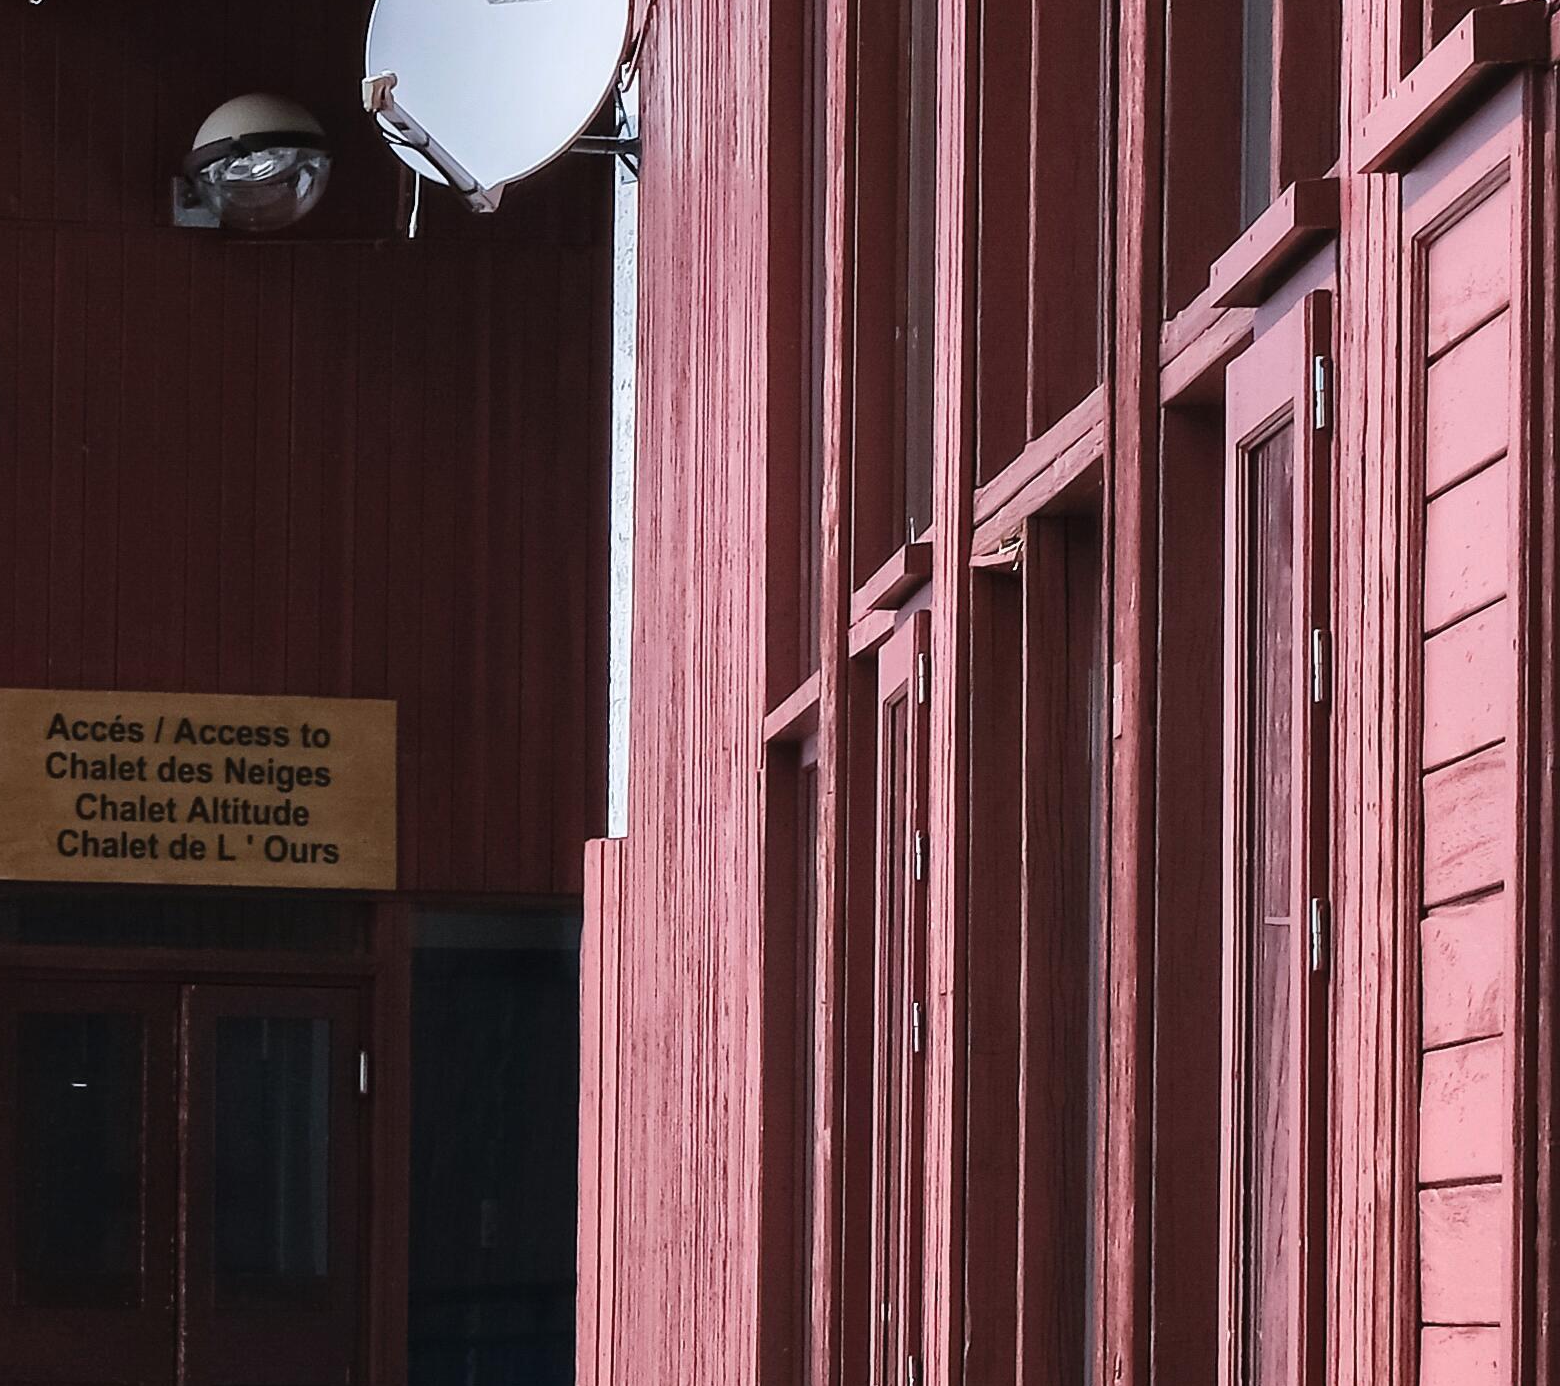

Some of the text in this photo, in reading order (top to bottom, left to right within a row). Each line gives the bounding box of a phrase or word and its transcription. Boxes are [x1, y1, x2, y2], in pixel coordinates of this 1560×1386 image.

[173, 717, 291, 748] Access
[299, 723, 331, 749] to
[45, 751, 332, 793] Chalet des Neiges
[75, 792, 310, 827] Chalet Altitude
[56, 828, 159, 860] Chalet
[167, 832, 207, 862] de
